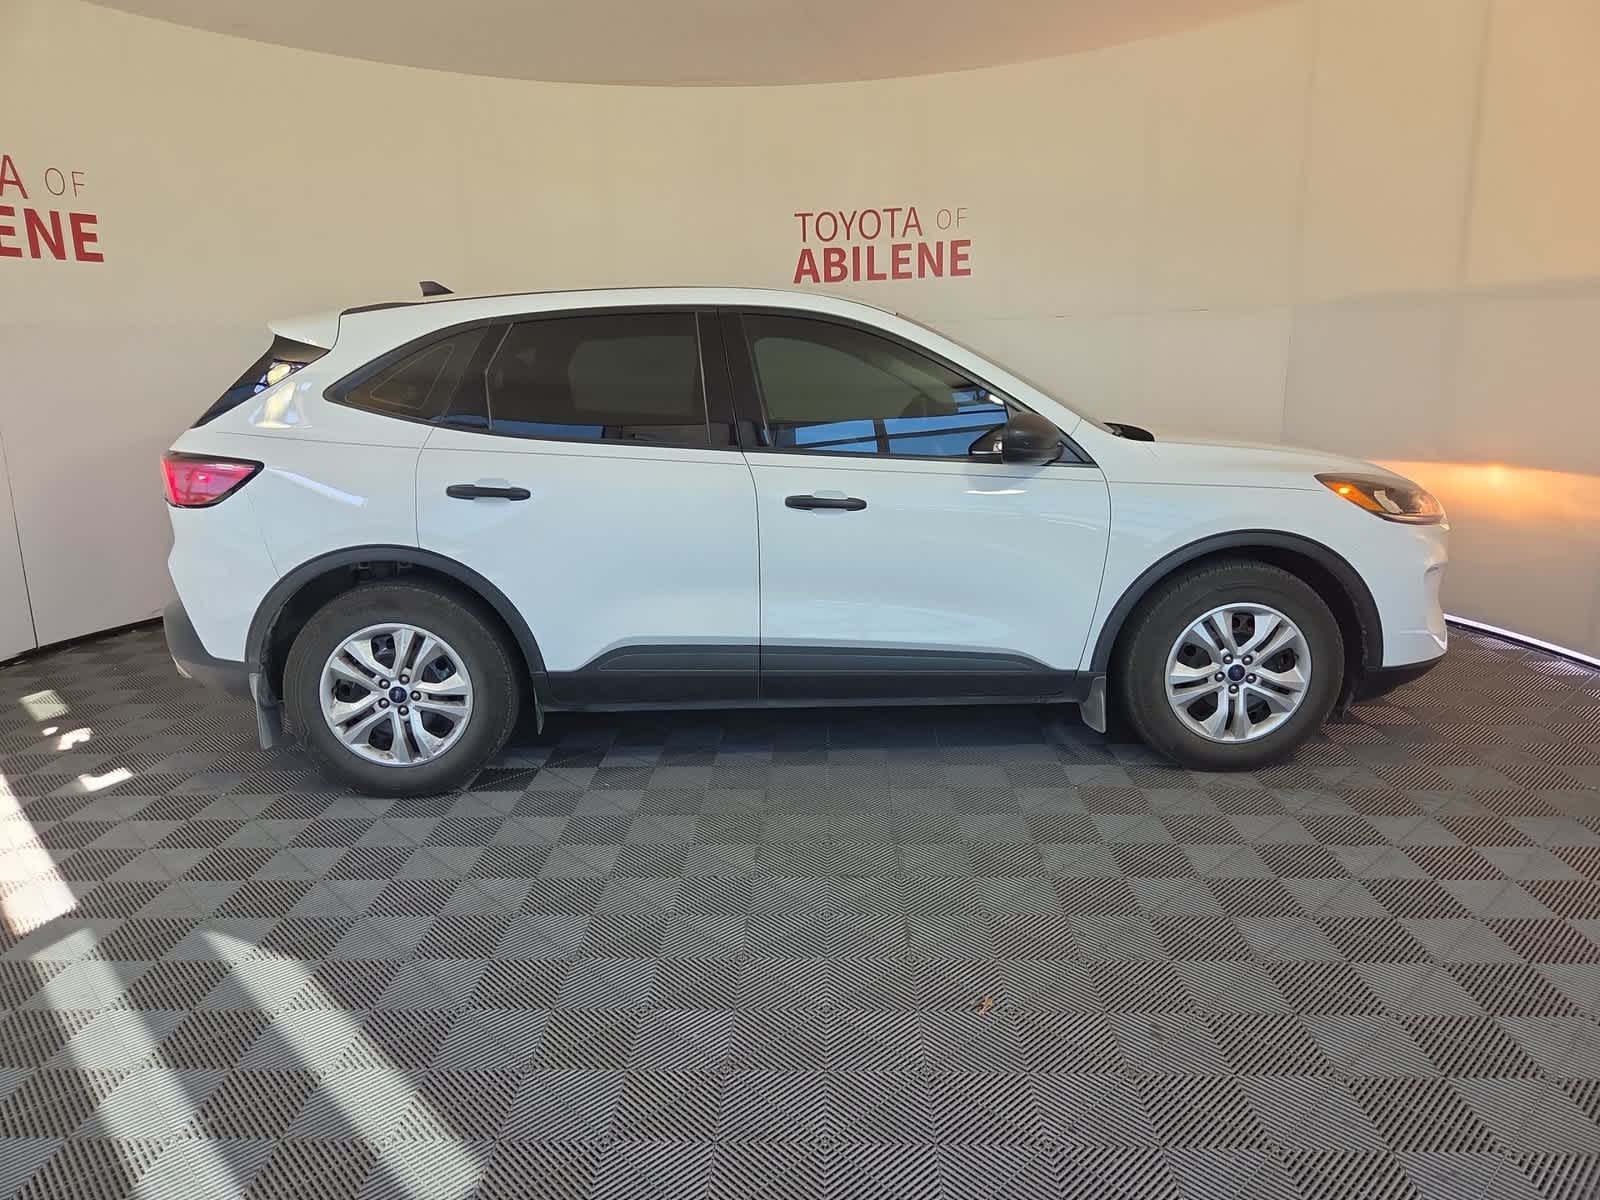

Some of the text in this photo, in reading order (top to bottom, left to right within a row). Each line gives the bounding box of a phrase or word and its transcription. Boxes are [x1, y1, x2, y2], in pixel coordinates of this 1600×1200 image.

[44, 167, 86, 198] OF
[794, 206, 969, 243] TOYOTA OF
[792, 239, 972, 284] ABILENE
